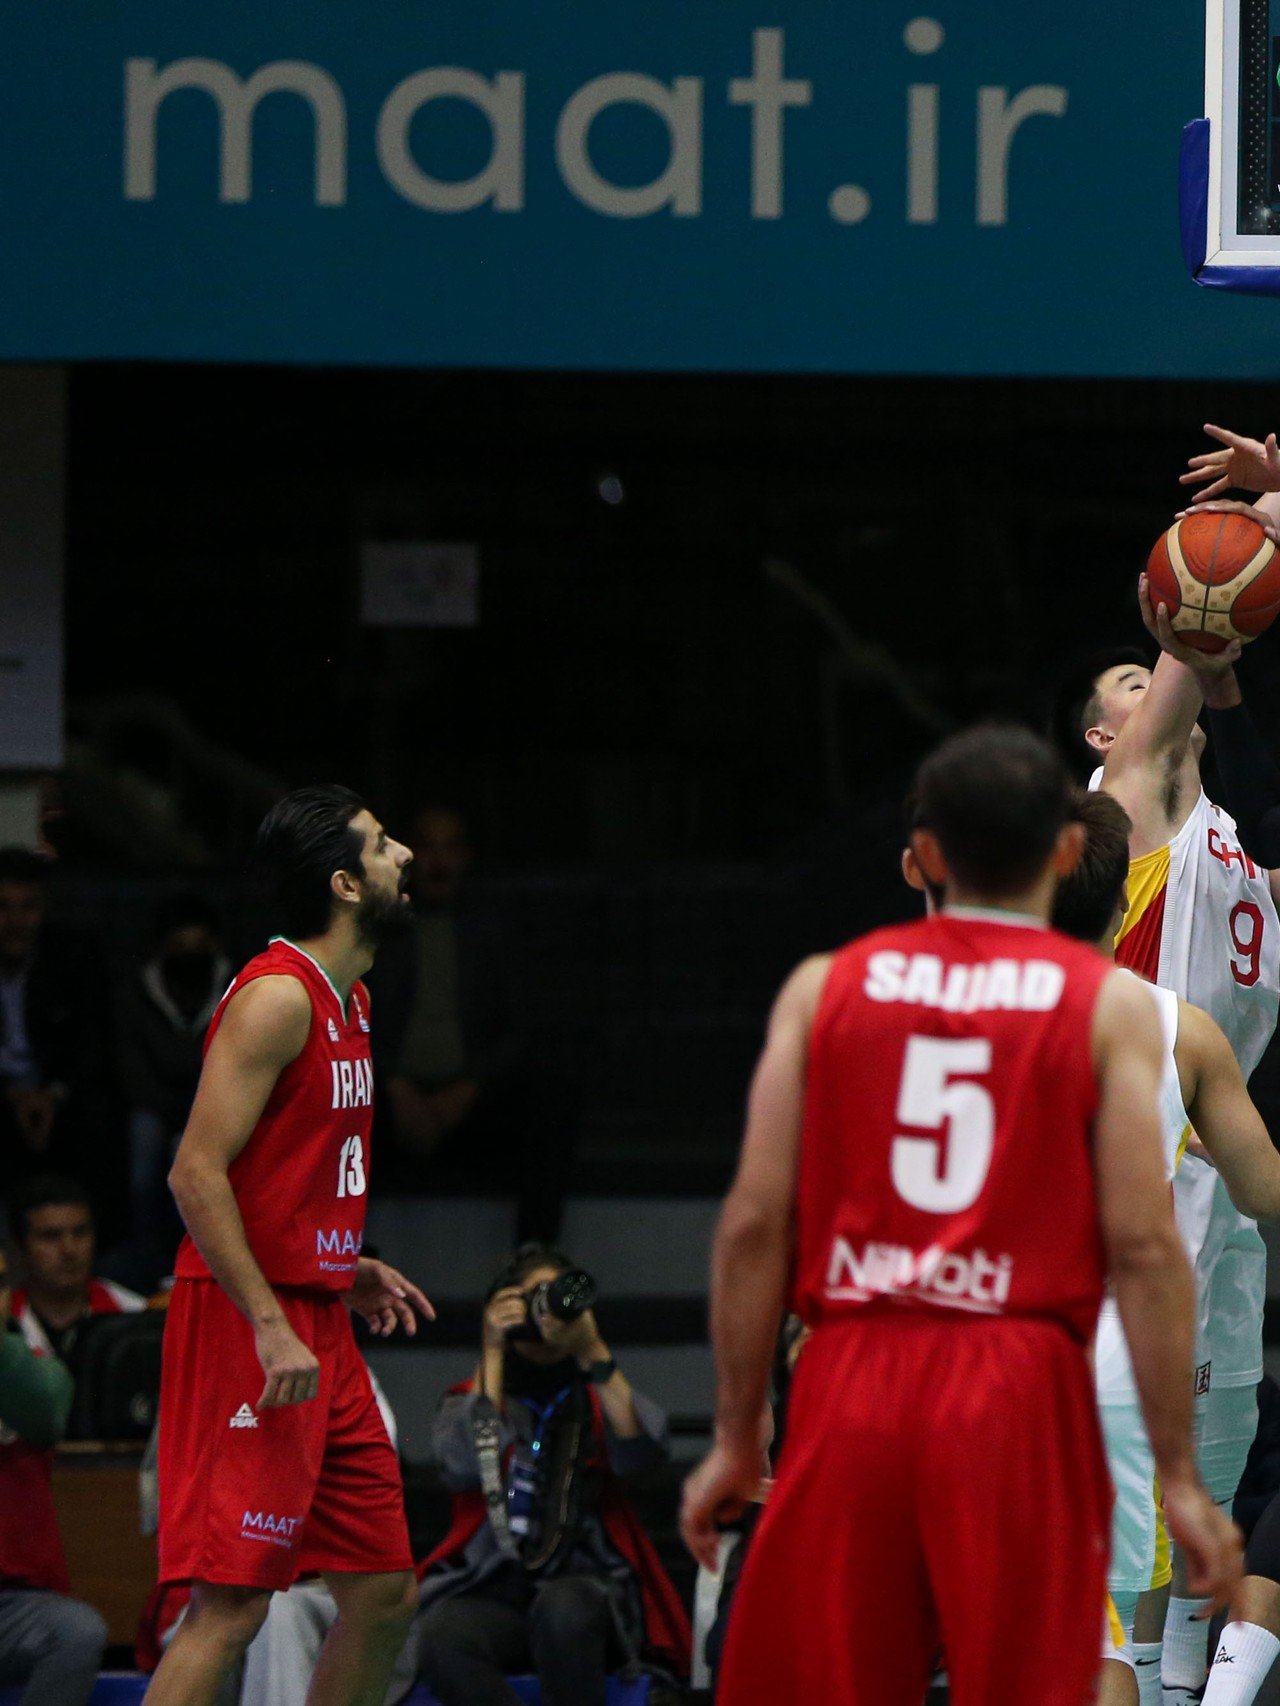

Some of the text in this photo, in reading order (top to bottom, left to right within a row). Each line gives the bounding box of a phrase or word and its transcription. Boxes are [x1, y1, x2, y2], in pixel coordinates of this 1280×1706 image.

[124, 17, 1068, 227] maat.ir
[1229, 900, 1265, 987] 9
[331, 1058, 374, 1109] IRAN
[890, 1034, 996, 1215] 5
[337, 1135, 367, 1198] 13
[241, 1510, 300, 1536] MAAT
